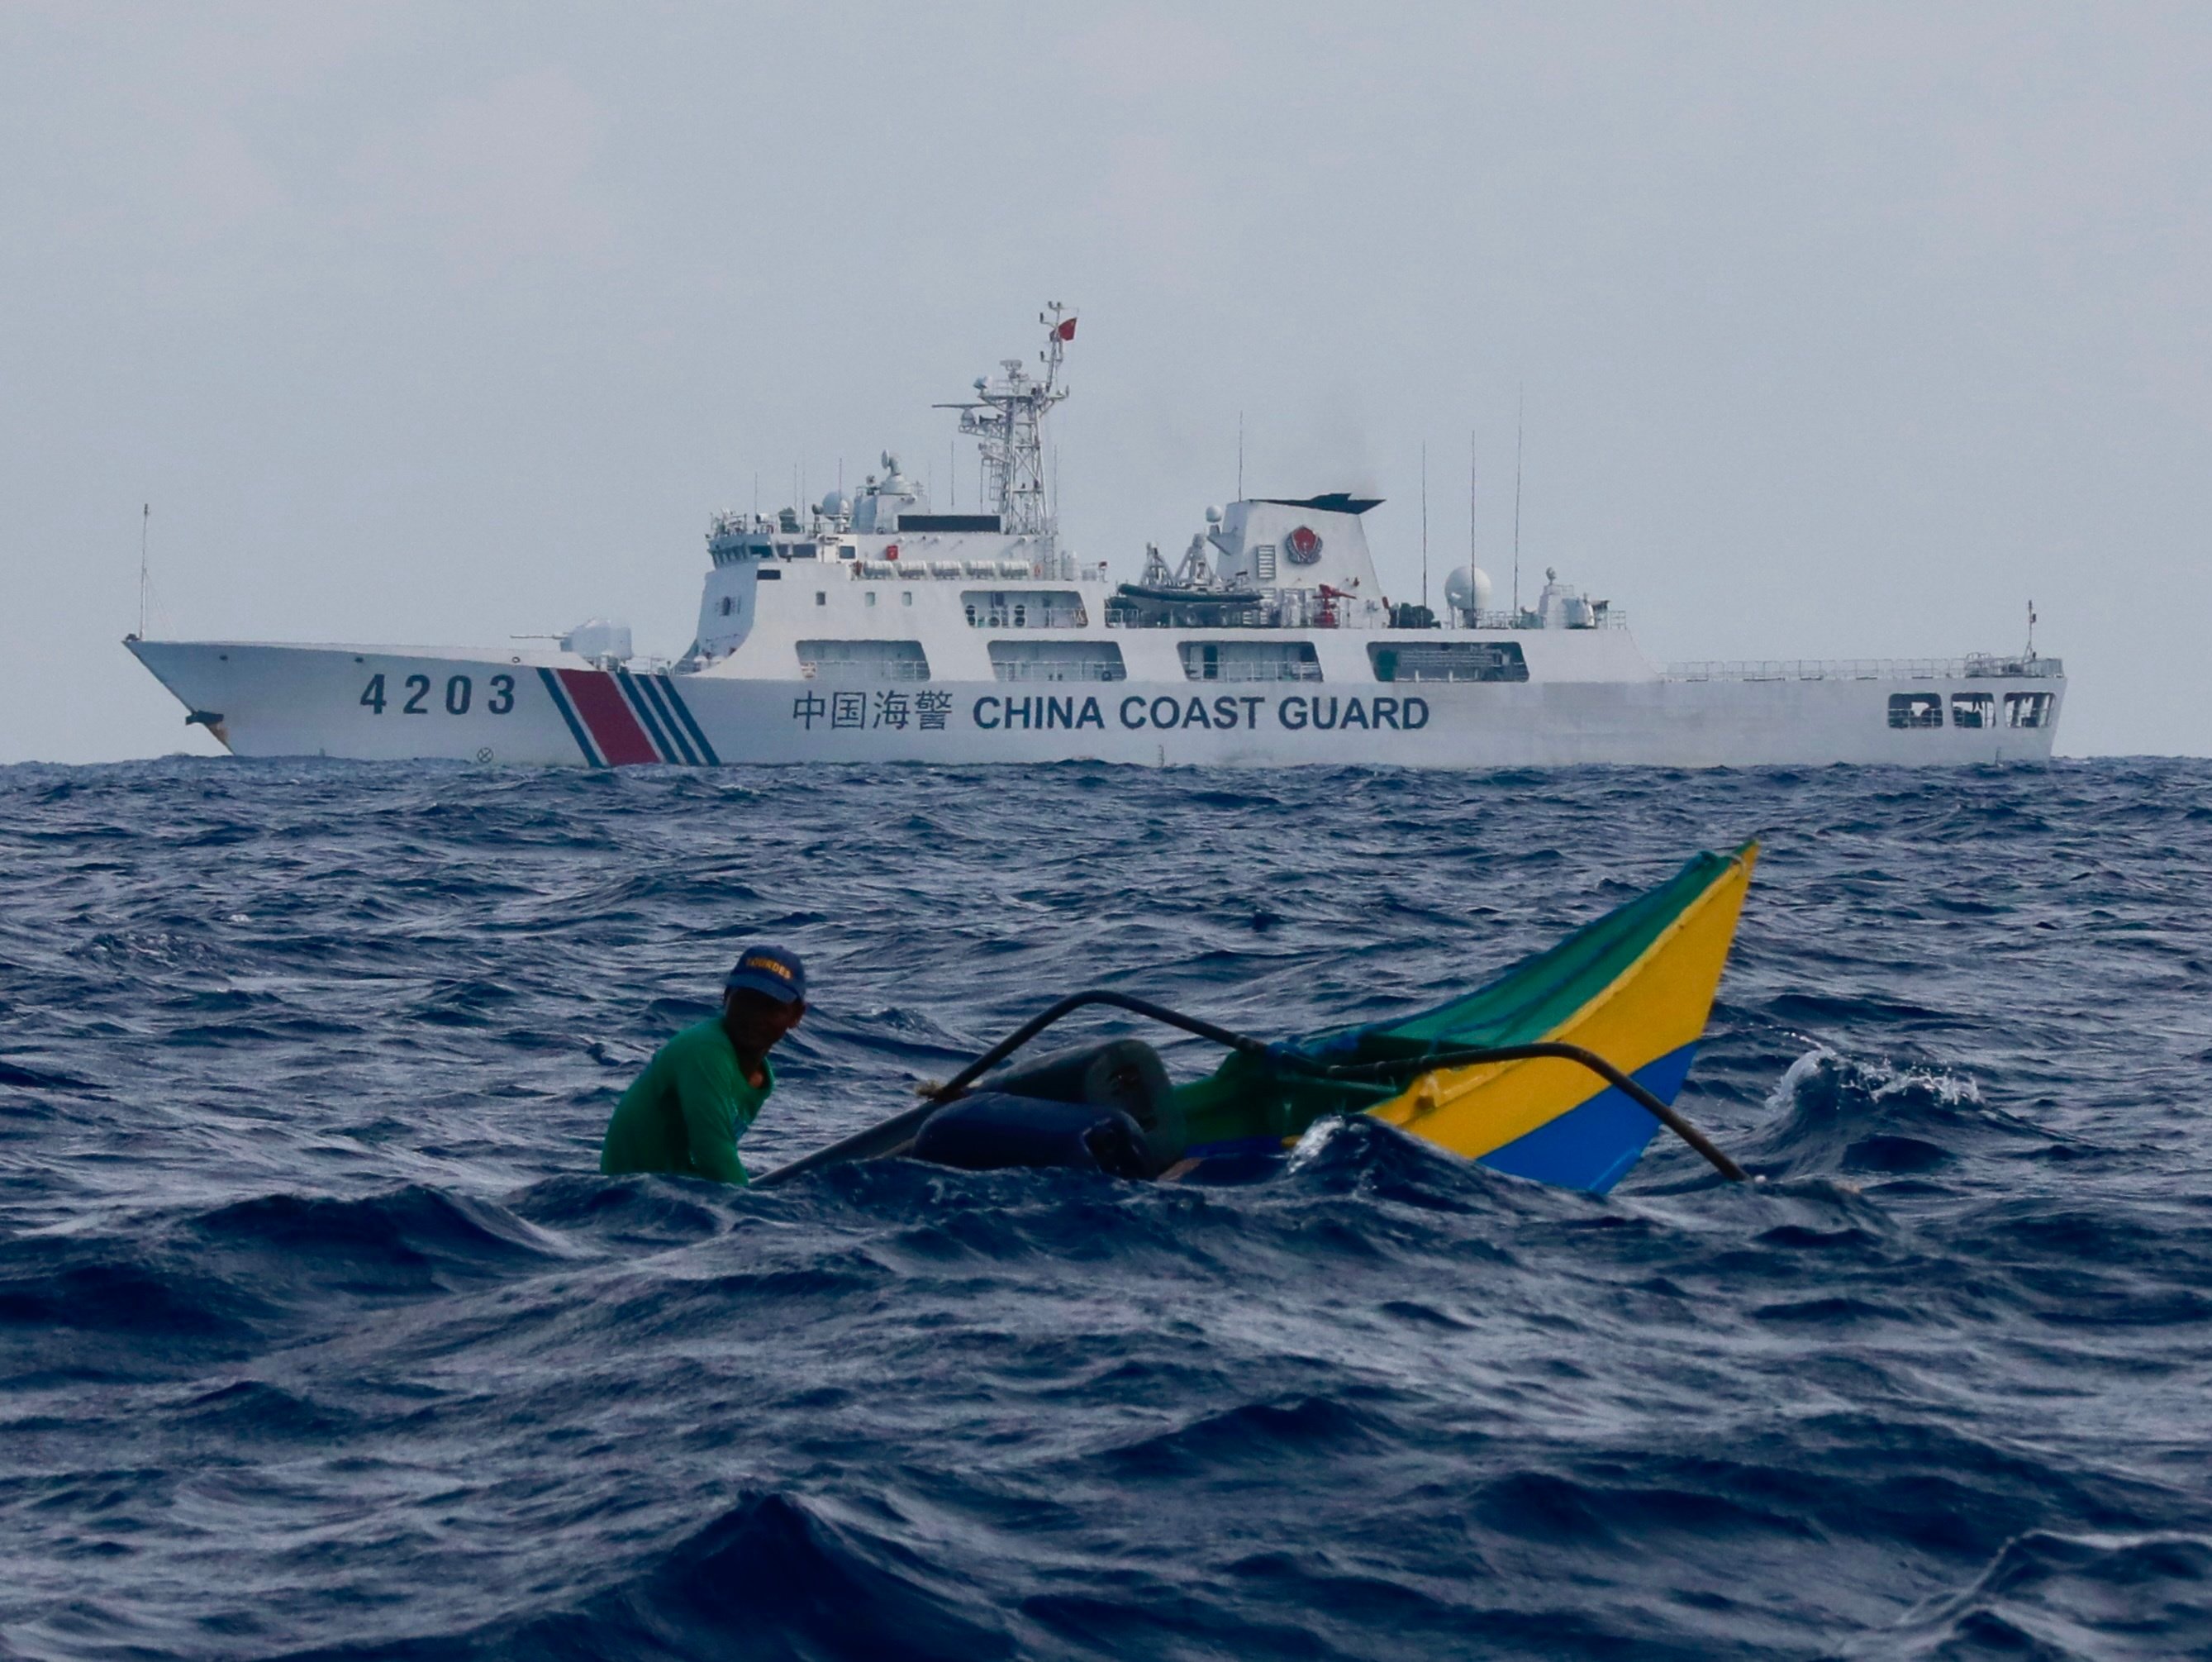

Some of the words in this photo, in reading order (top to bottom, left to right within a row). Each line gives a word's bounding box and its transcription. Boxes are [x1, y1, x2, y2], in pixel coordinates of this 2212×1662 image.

[359, 673, 516, 716] 4203
[792, 690, 954, 731] 中国海警
[972, 696, 1106, 731] CHINA
[1119, 695, 1266, 731] COAST
[1277, 696, 1430, 731] GUARD
